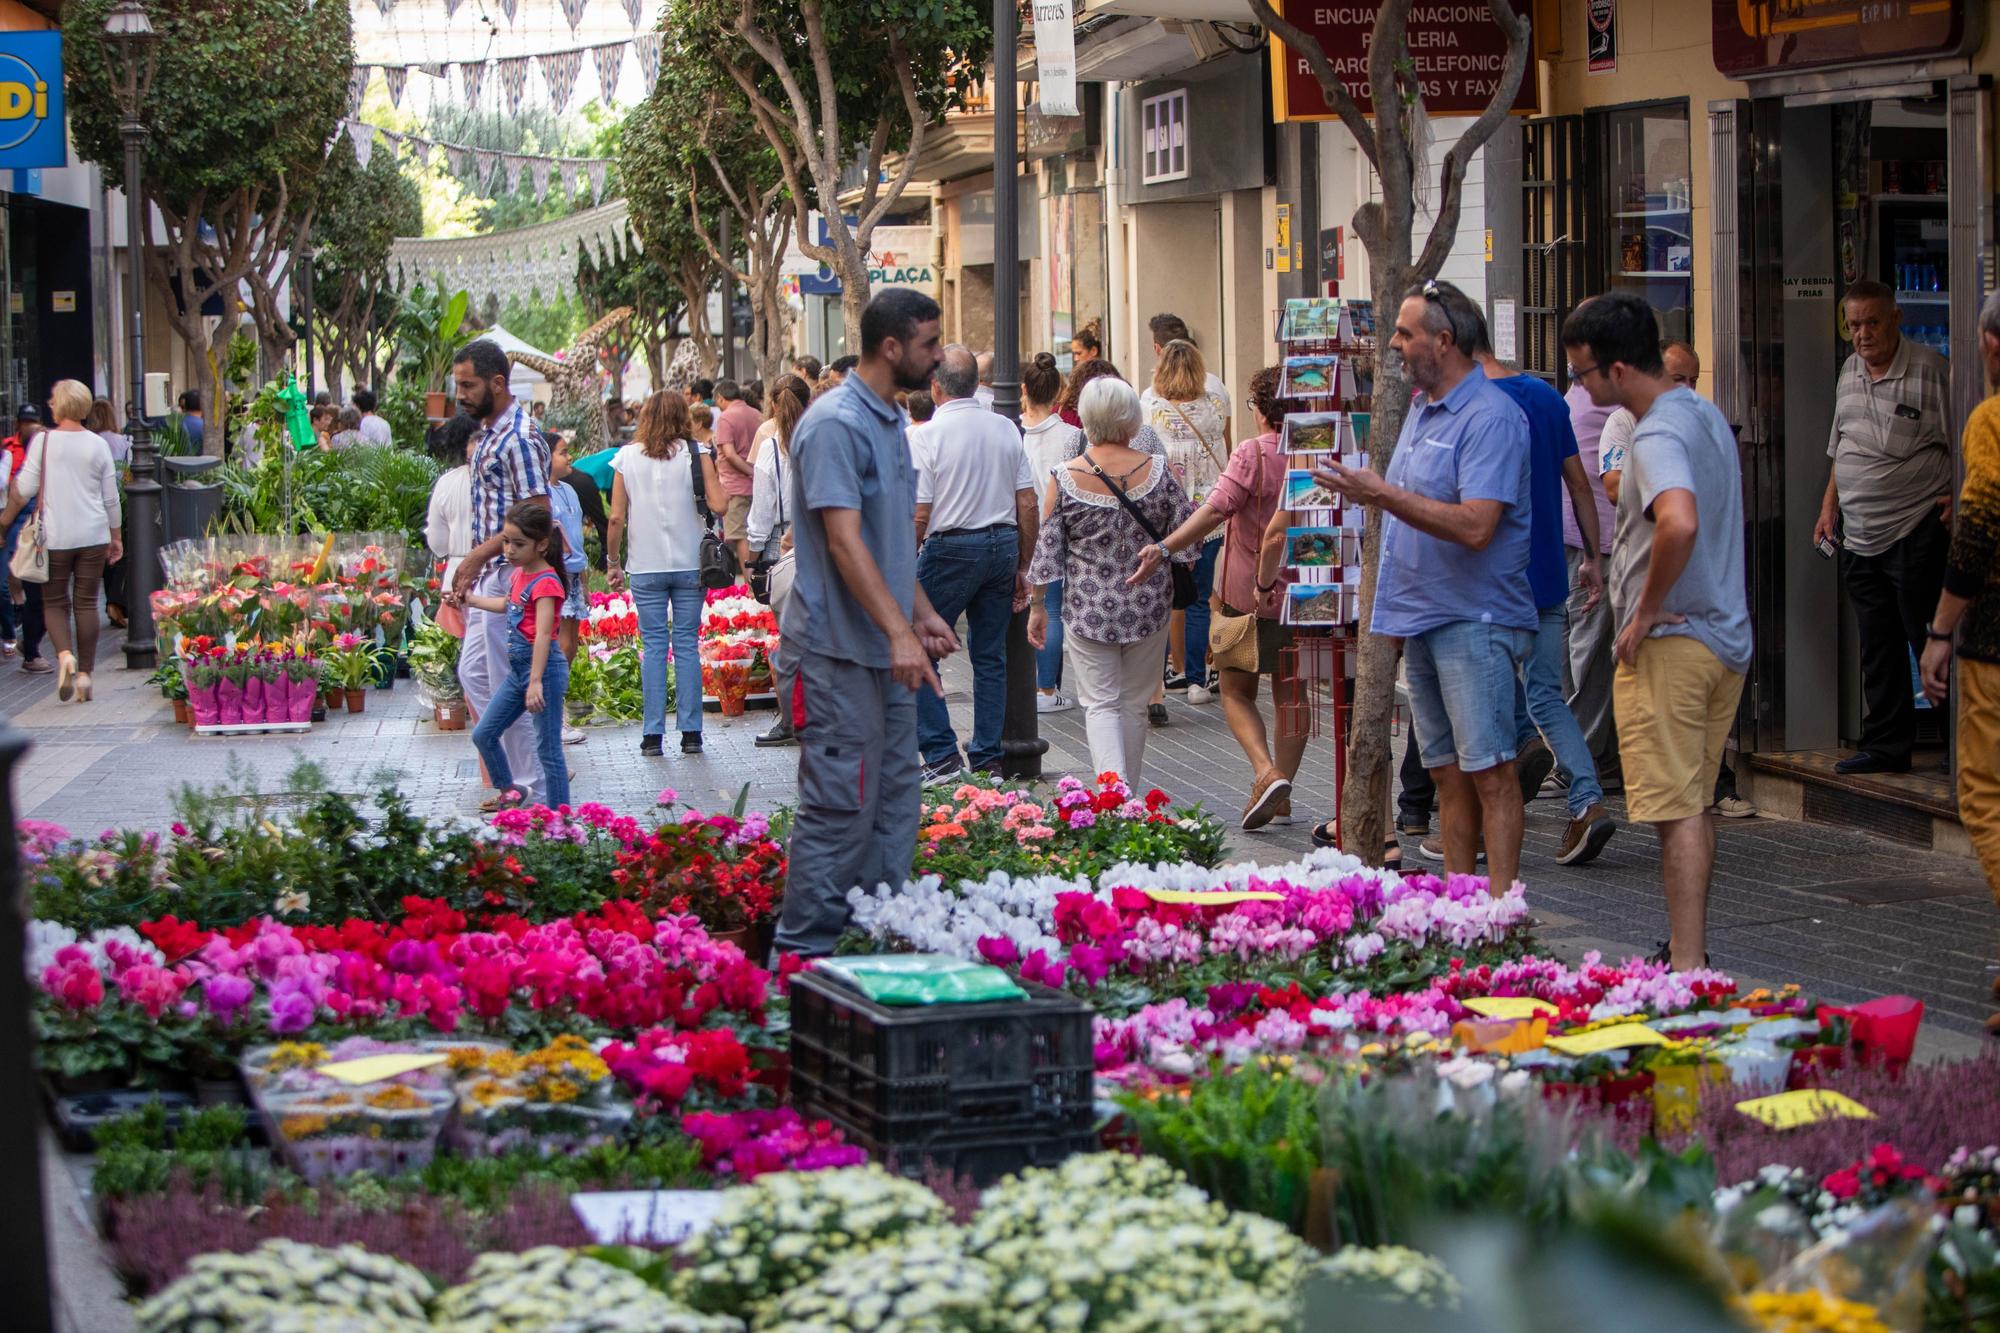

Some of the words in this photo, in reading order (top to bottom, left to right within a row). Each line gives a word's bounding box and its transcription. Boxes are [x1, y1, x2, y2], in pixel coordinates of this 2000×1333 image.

[1362, 32, 1458, 48] PLERIA
[1447, 80, 1458, 96] Y
[1465, 79, 1498, 96] FAX
[869, 267, 932, 284] PLAÇA
[1801, 277, 1833, 286] BEBIDA
[1797, 289, 1823, 298] FRIAS
